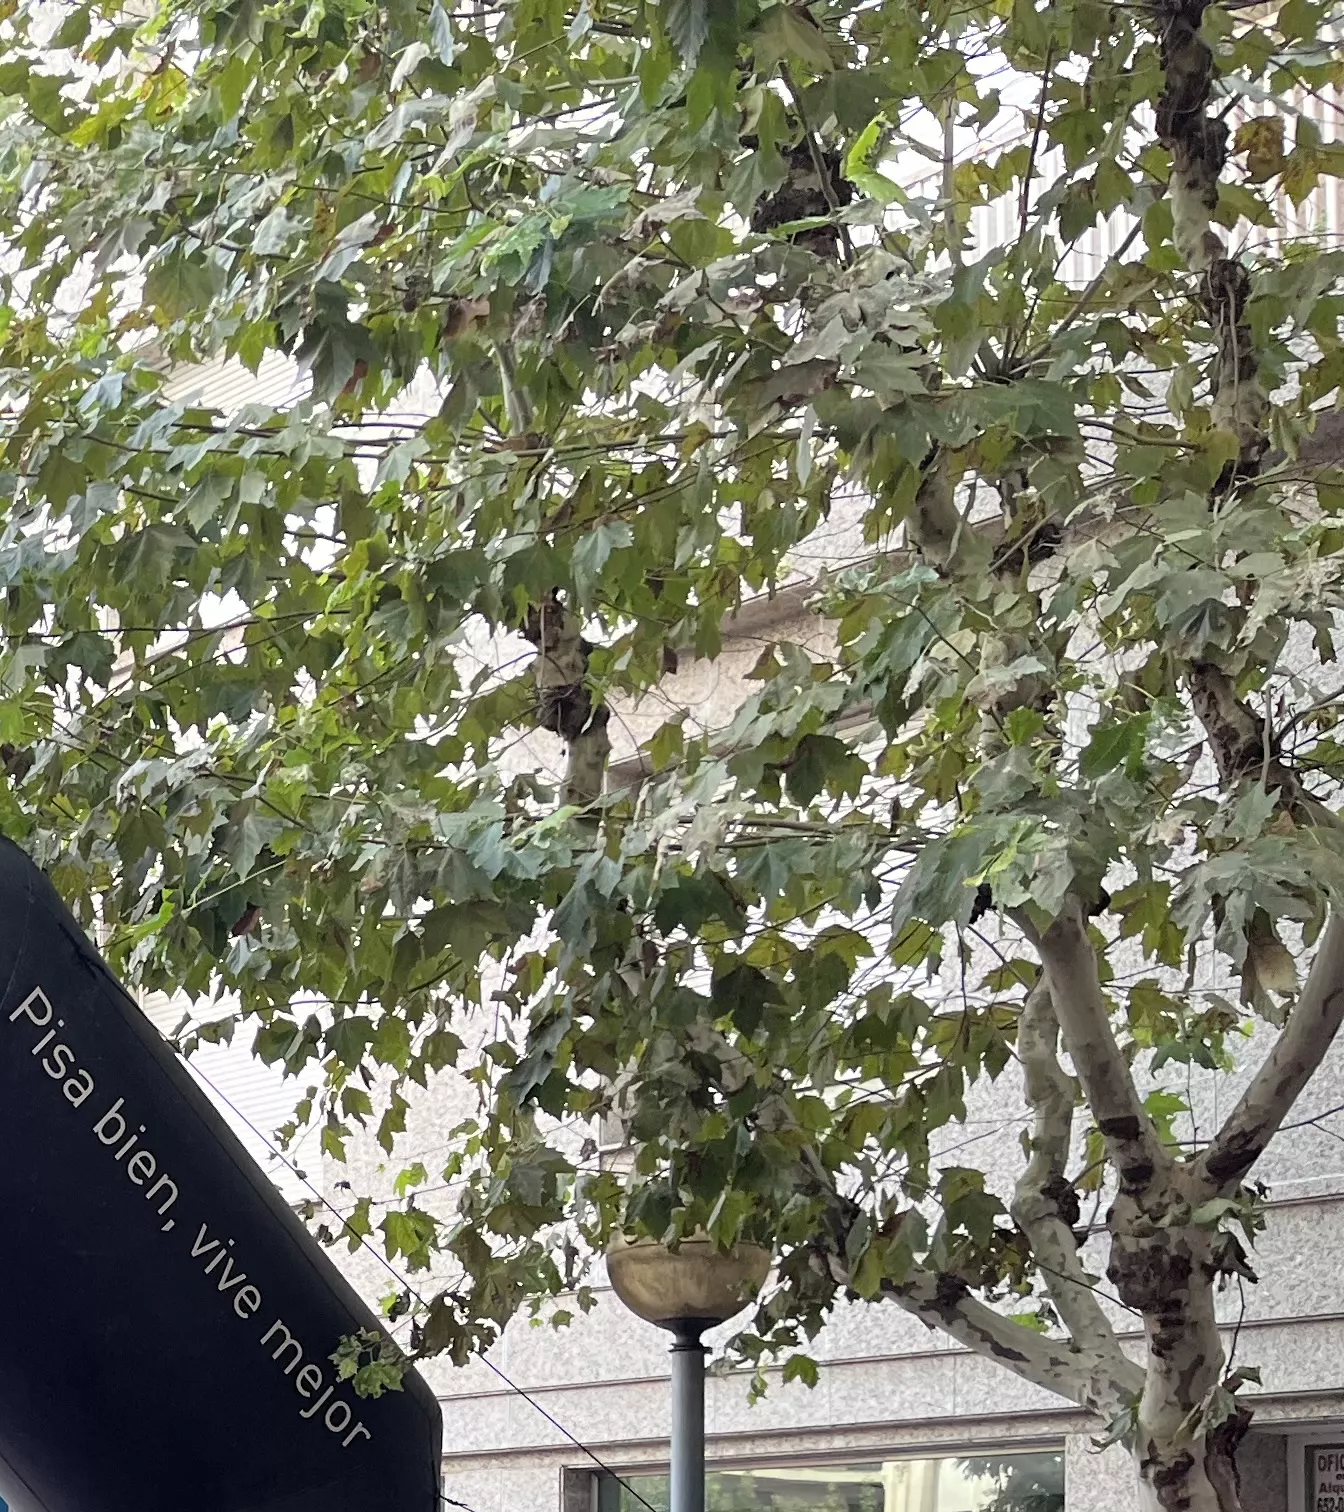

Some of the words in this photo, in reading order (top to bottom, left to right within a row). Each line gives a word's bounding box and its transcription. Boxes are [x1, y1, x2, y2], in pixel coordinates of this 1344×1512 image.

[8, 985, 96, 1109] Pisa
[92, 1096, 180, 1232] bien,
[189, 1222, 263, 1320] vive
[258, 1318, 373, 1449] mejor
